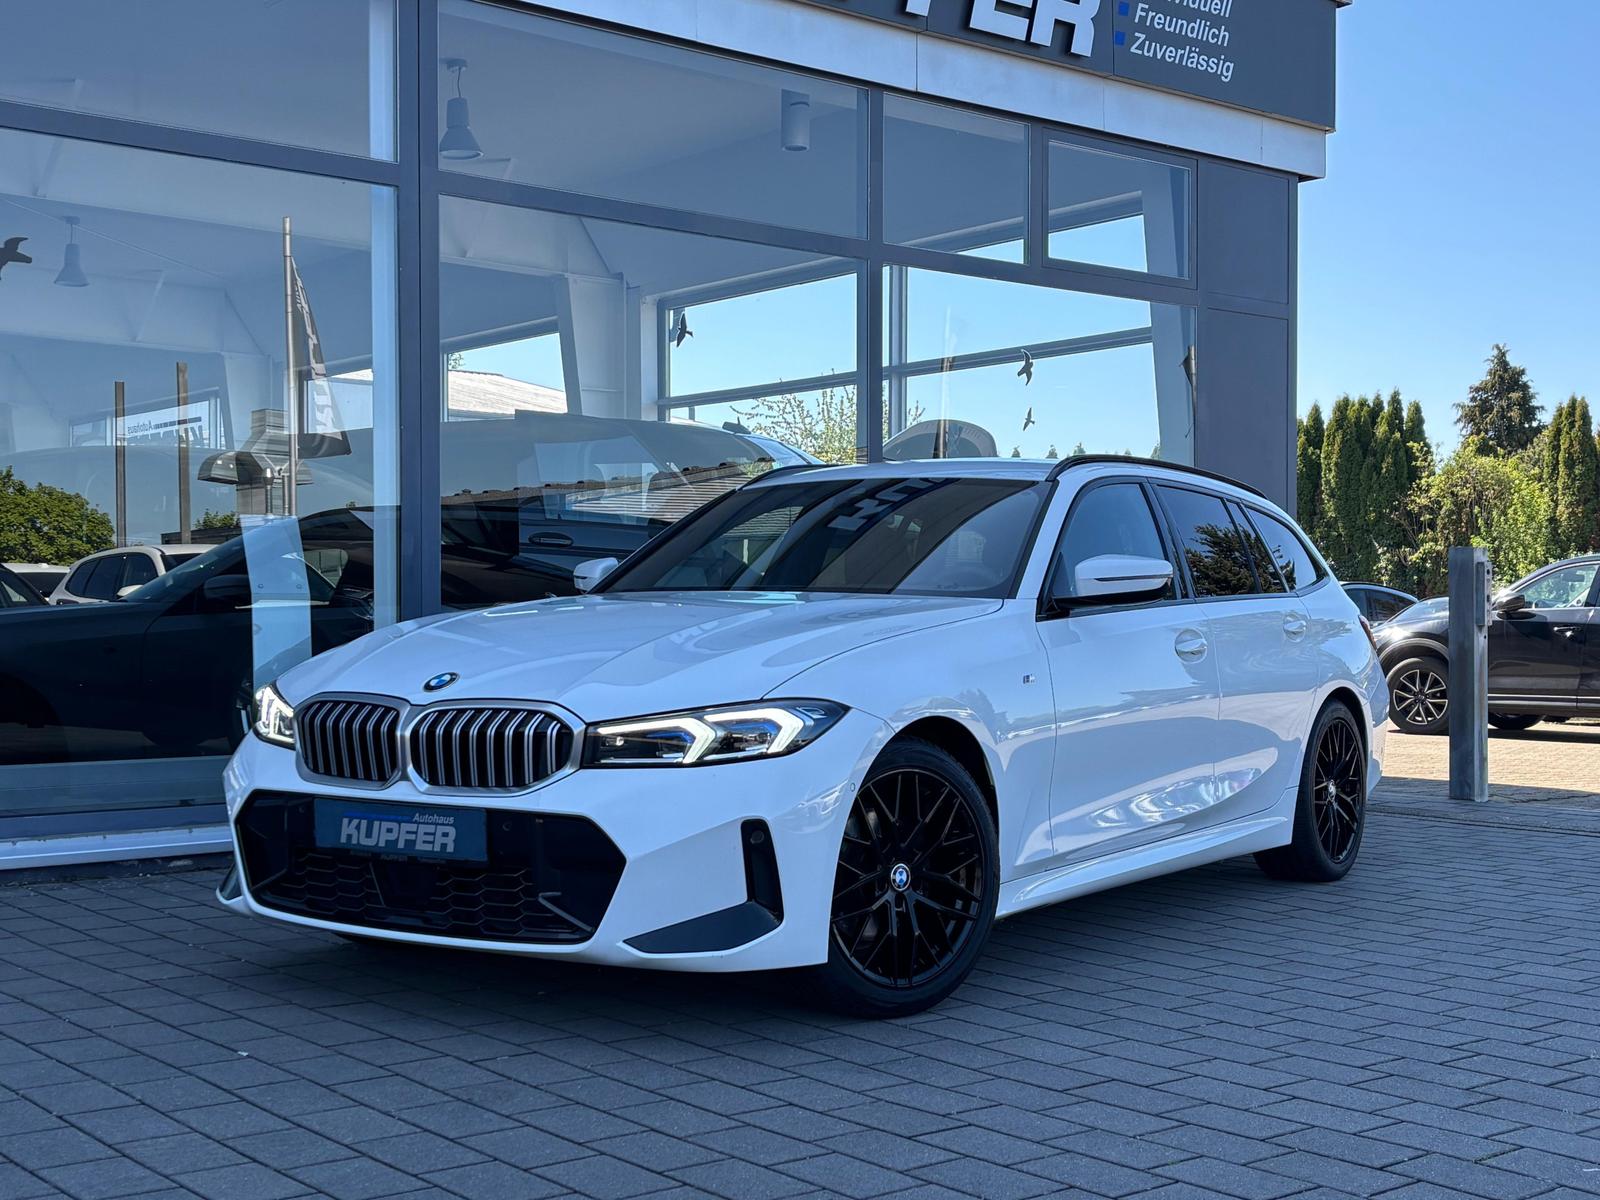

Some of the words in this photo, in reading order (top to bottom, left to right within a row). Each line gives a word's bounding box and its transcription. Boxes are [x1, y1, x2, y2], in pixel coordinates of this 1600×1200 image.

[1134, 2, 1229, 47] Freundlich
[1130, 32, 1234, 83] Zuverlässig
[340, 817, 456, 853] KUPFER
[412, 812, 454, 824] Autohaus
